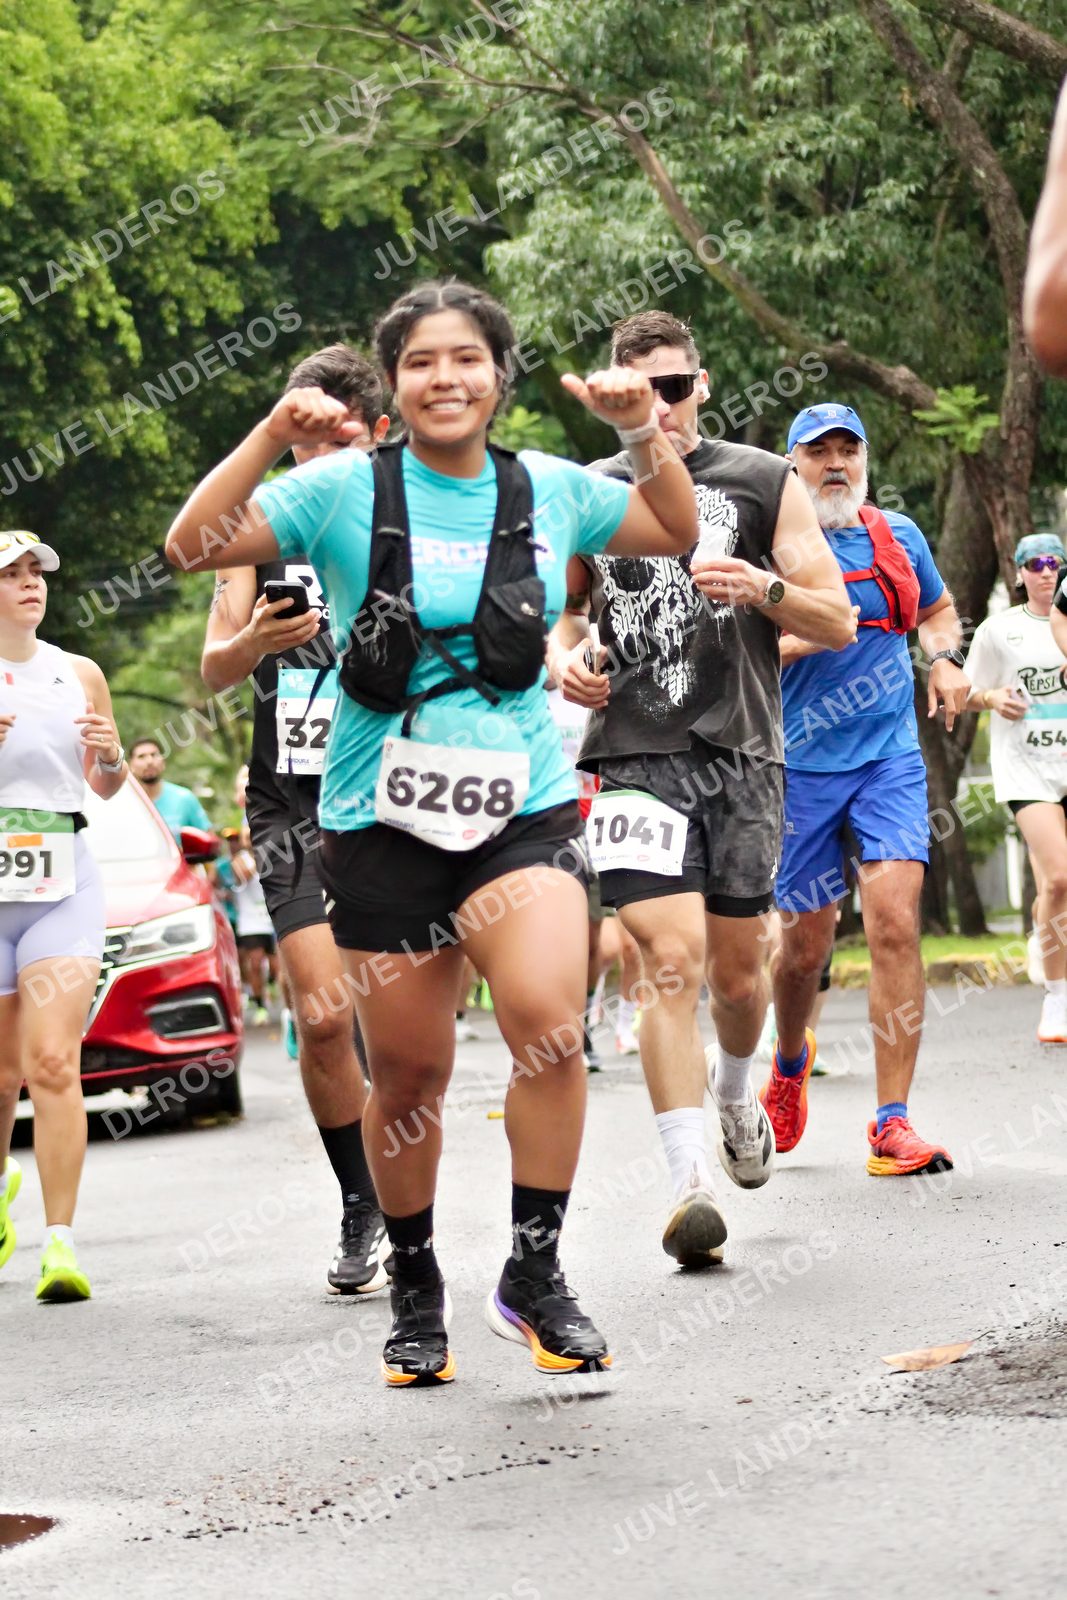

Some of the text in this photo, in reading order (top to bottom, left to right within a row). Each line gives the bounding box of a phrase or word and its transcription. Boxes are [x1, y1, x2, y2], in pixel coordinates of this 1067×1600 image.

[285, 718, 331, 749] 32
[1027, 731, 1067, 747] 454
[387, 766, 515, 818] 6268
[594, 814, 674, 851] 1041
[0, 850, 53, 878] 991
